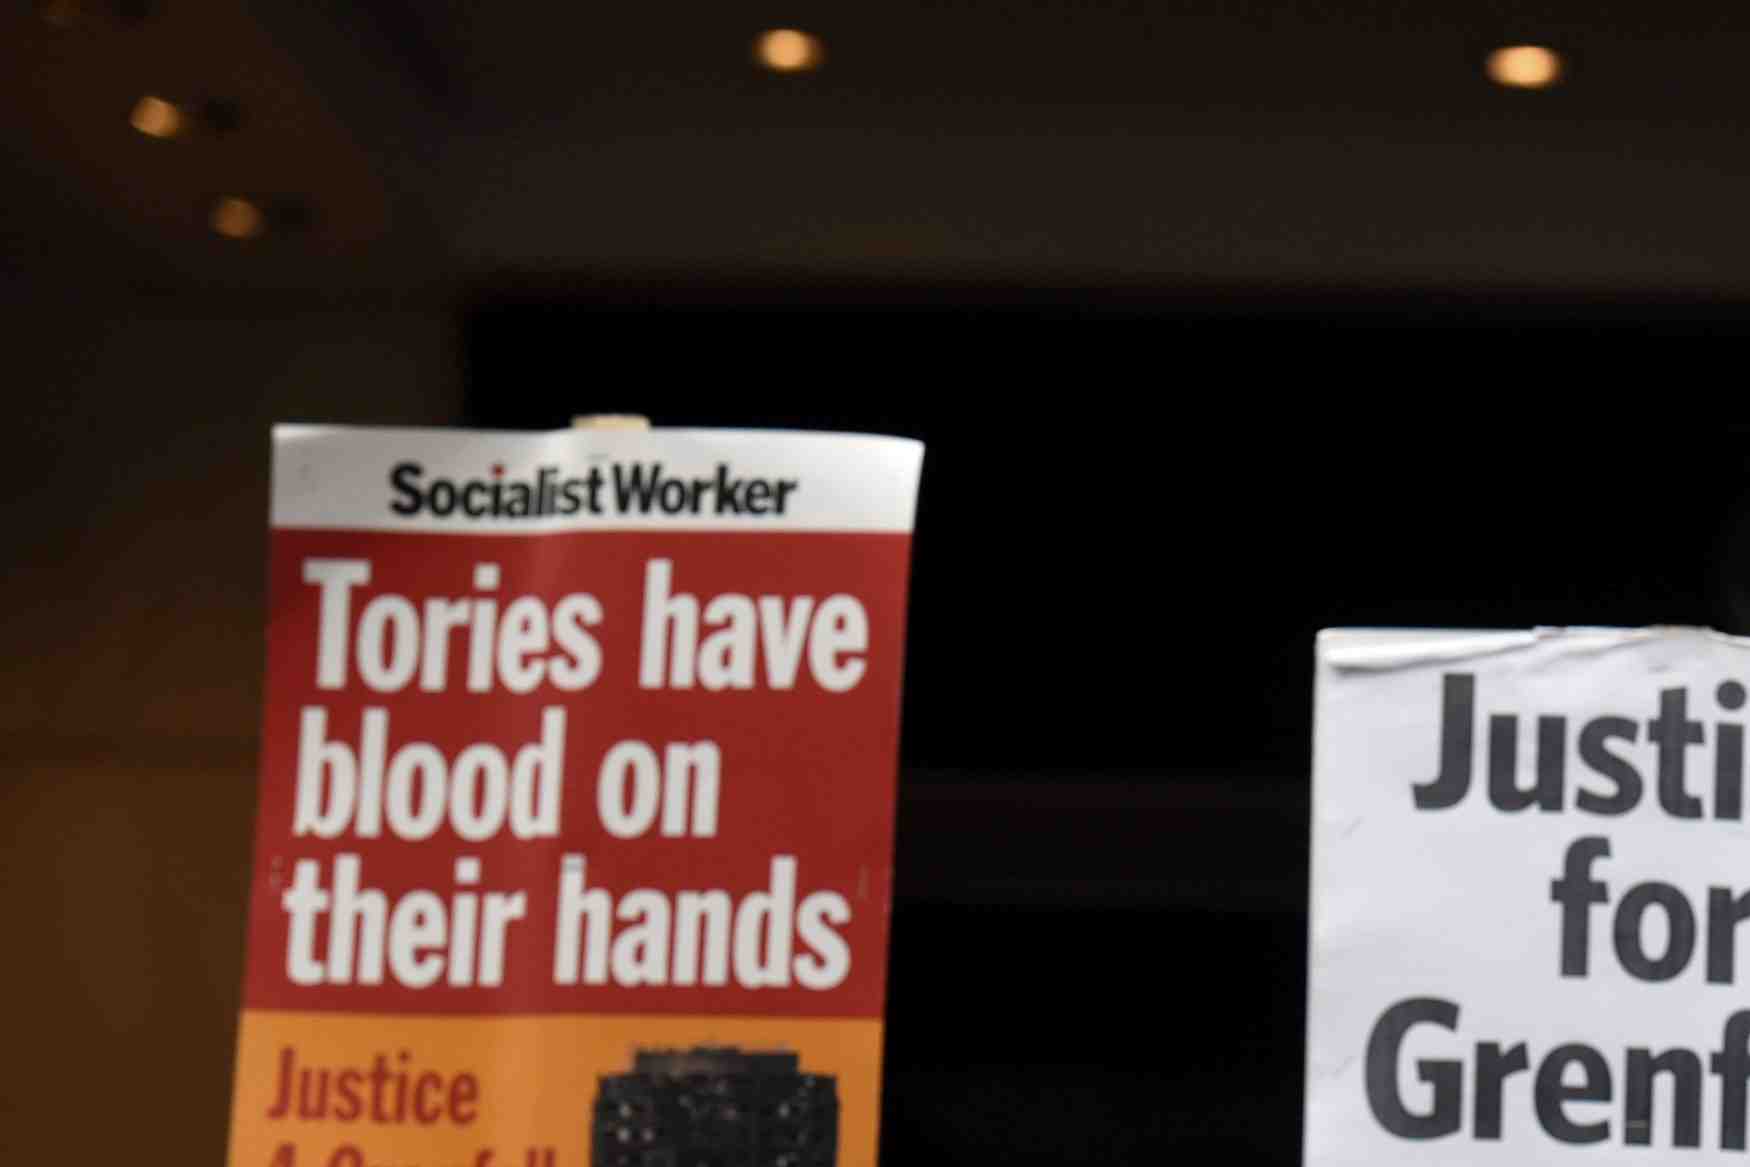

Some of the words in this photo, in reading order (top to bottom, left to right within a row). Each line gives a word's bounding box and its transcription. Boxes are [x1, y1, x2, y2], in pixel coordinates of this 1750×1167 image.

[390, 462, 603, 518] Socialist
[612, 462, 798, 515] Worker
[302, 559, 602, 693] Tories
[638, 559, 868, 692] have
[293, 707, 567, 841] blood
[598, 739, 720, 840] on
[282, 856, 527, 988] their
[553, 856, 852, 988] hands
[266, 1048, 479, 1127] Justice
